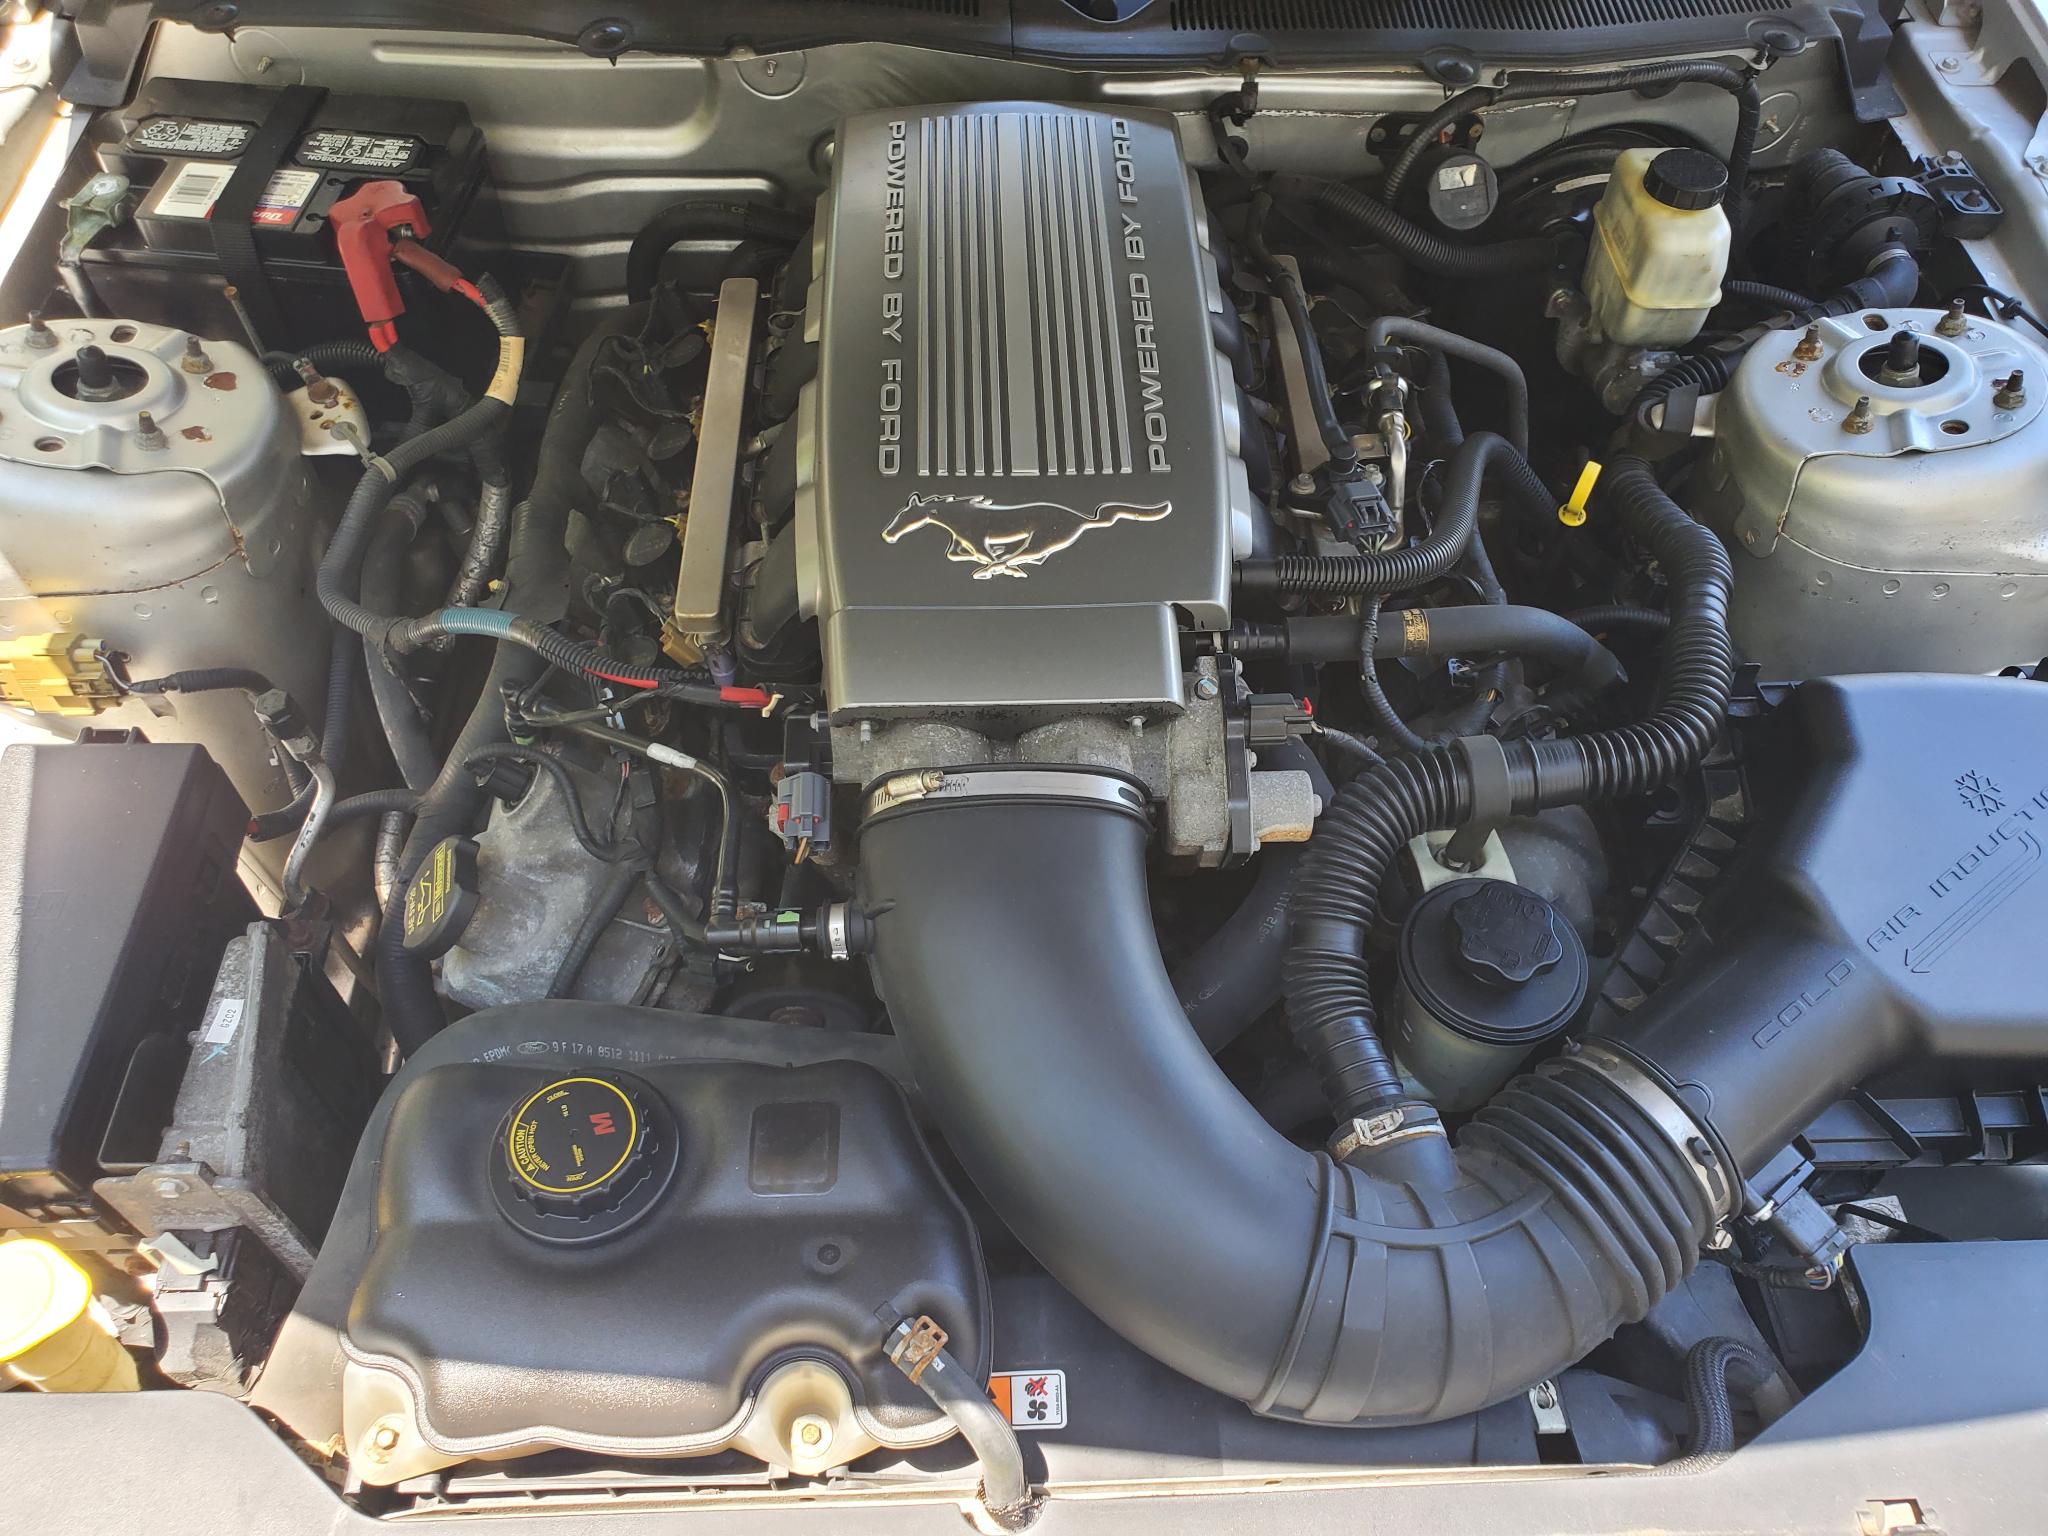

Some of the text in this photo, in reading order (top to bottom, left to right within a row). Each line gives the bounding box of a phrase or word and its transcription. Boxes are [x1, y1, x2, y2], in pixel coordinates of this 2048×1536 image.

[878, 120, 906, 476] POWERED BY FORD
[1110, 117, 1172, 474] POWERED BY FORD
[1752, 958, 1856, 1049] COLD
[1866, 903, 1923, 953] AIR
[515, 1129, 529, 1166] CAUTION
[527, 1119, 551, 1172] NEVER OPEN HOT
[589, 1112, 616, 1136] M
